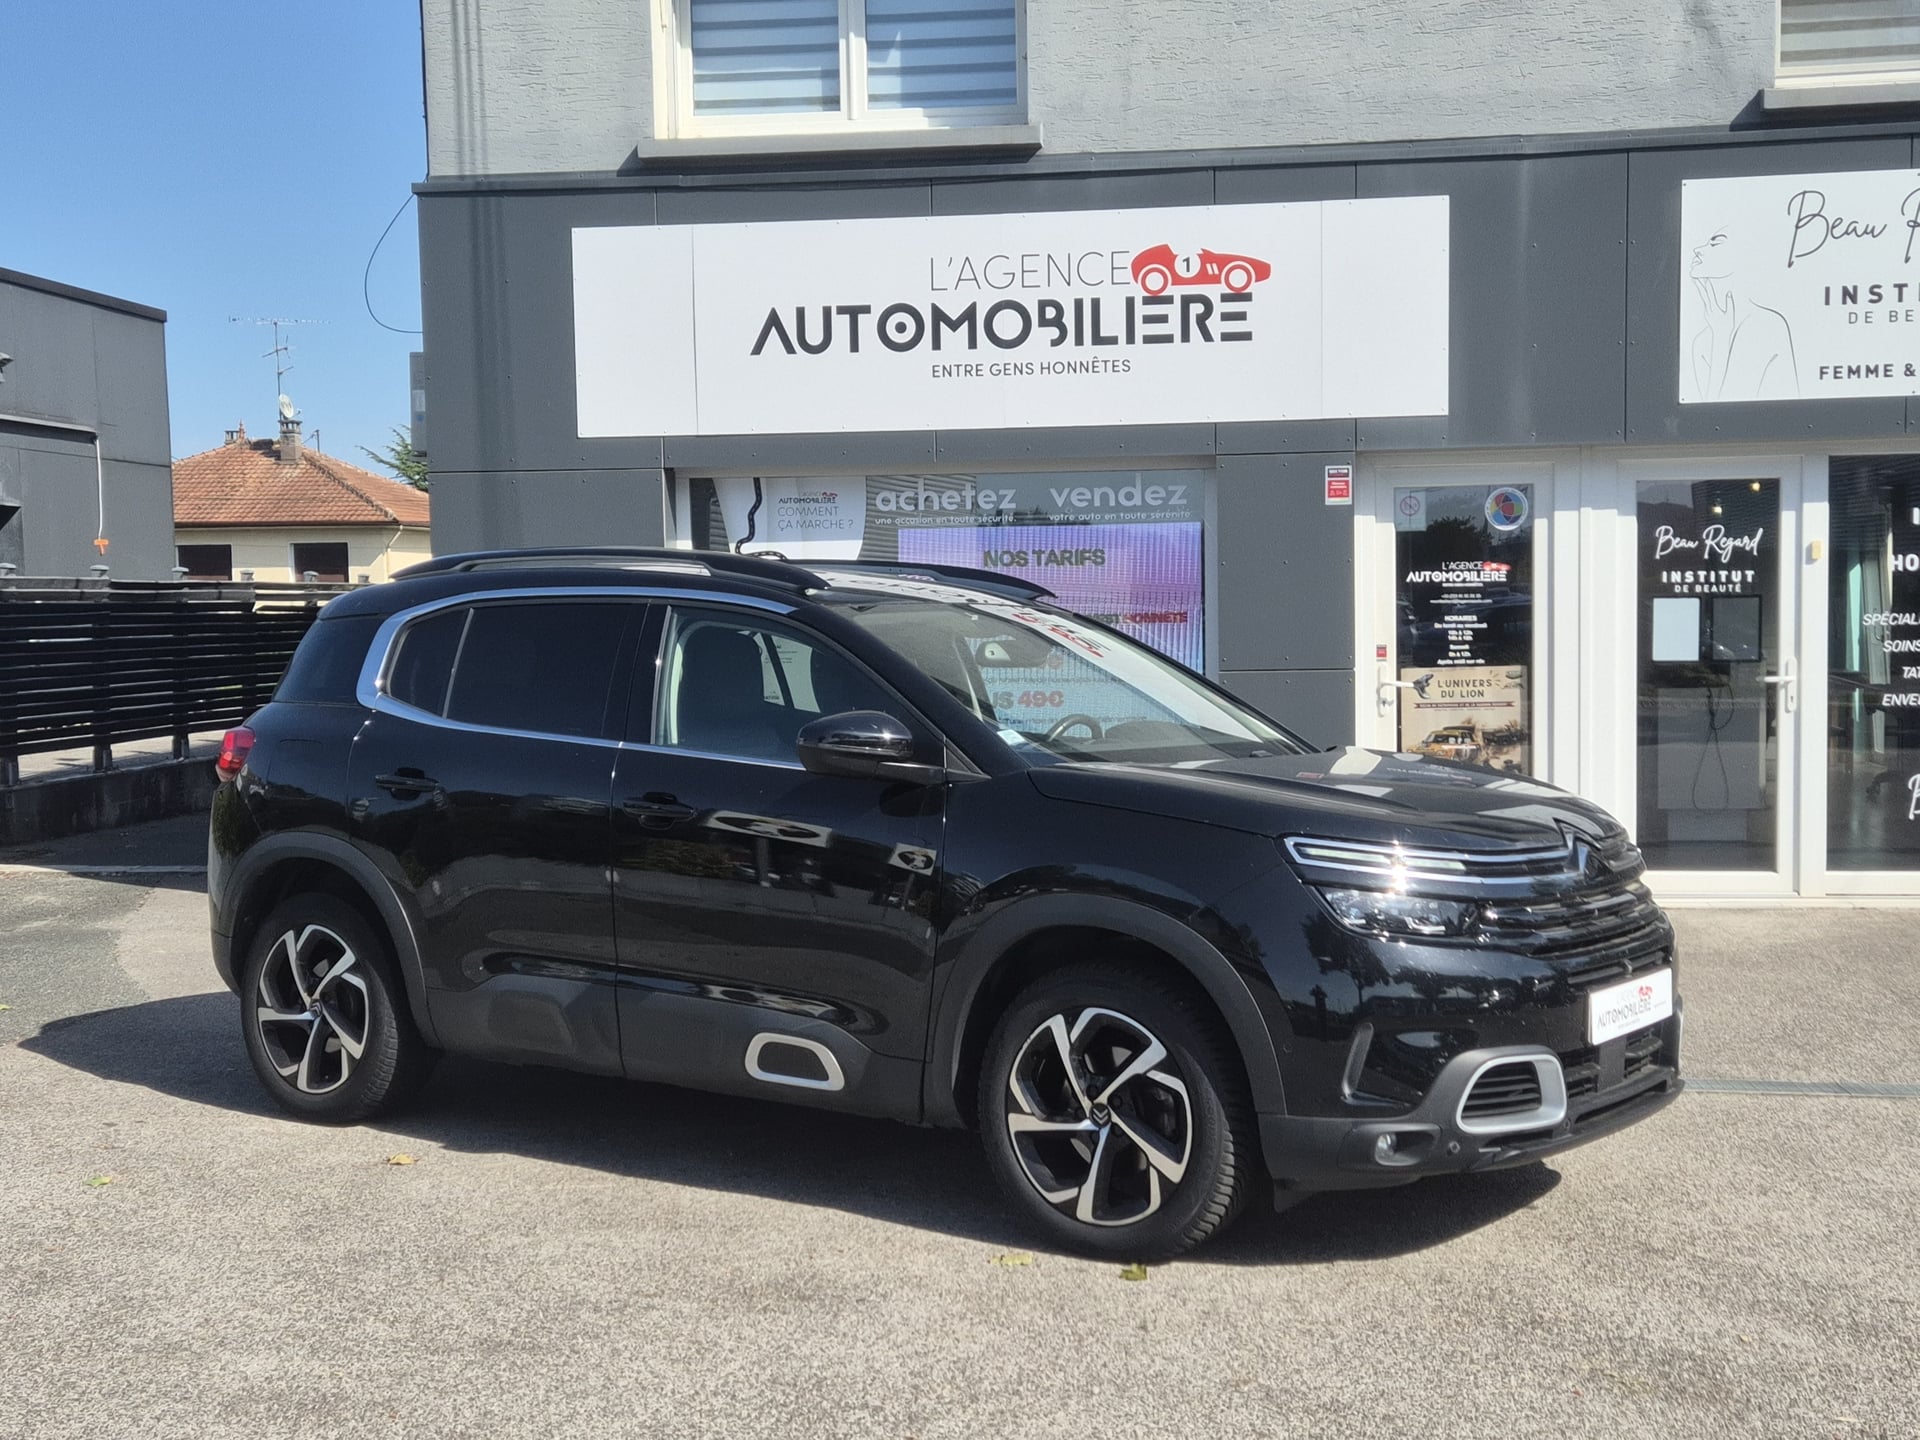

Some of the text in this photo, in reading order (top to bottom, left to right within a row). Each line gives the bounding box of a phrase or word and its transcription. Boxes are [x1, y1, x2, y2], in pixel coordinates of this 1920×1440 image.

[1787, 190, 1887, 268] Beau
[931, 251, 1131, 291] L'AGENCE
[1848, 312, 1874, 324] DE
[932, 356, 1131, 378] ENTRE GENS HONNÊTES
[1819, 363, 1917, 380] FEMME &
[875, 477, 1017, 512] achetez
[1050, 473, 1187, 508] vendez
[777, 506, 839, 517] COMMENT
[1049, 513, 1075, 521] votre
[1078, 513, 1101, 521] auto
[1105, 512, 1117, 520] en
[1120, 511, 1147, 520] toute
[777, 520, 793, 532] ÇA
[796, 520, 845, 529] MARCHE
[875, 517, 892, 525] une
[894, 515, 933, 525] occasion
[949, 514, 976, 524] toute
[1655, 524, 1764, 563] Beau Regard
[984, 548, 1105, 568] NOS TARIFS
[1662, 570, 1755, 583] INSTITUT
[1674, 583, 1741, 593] DE BEAUTÉ
[1862, 611, 1920, 626] SPÉCIAL
[1441, 689, 1485, 698] DU LION
[1882, 693, 1920, 706] ENVE
